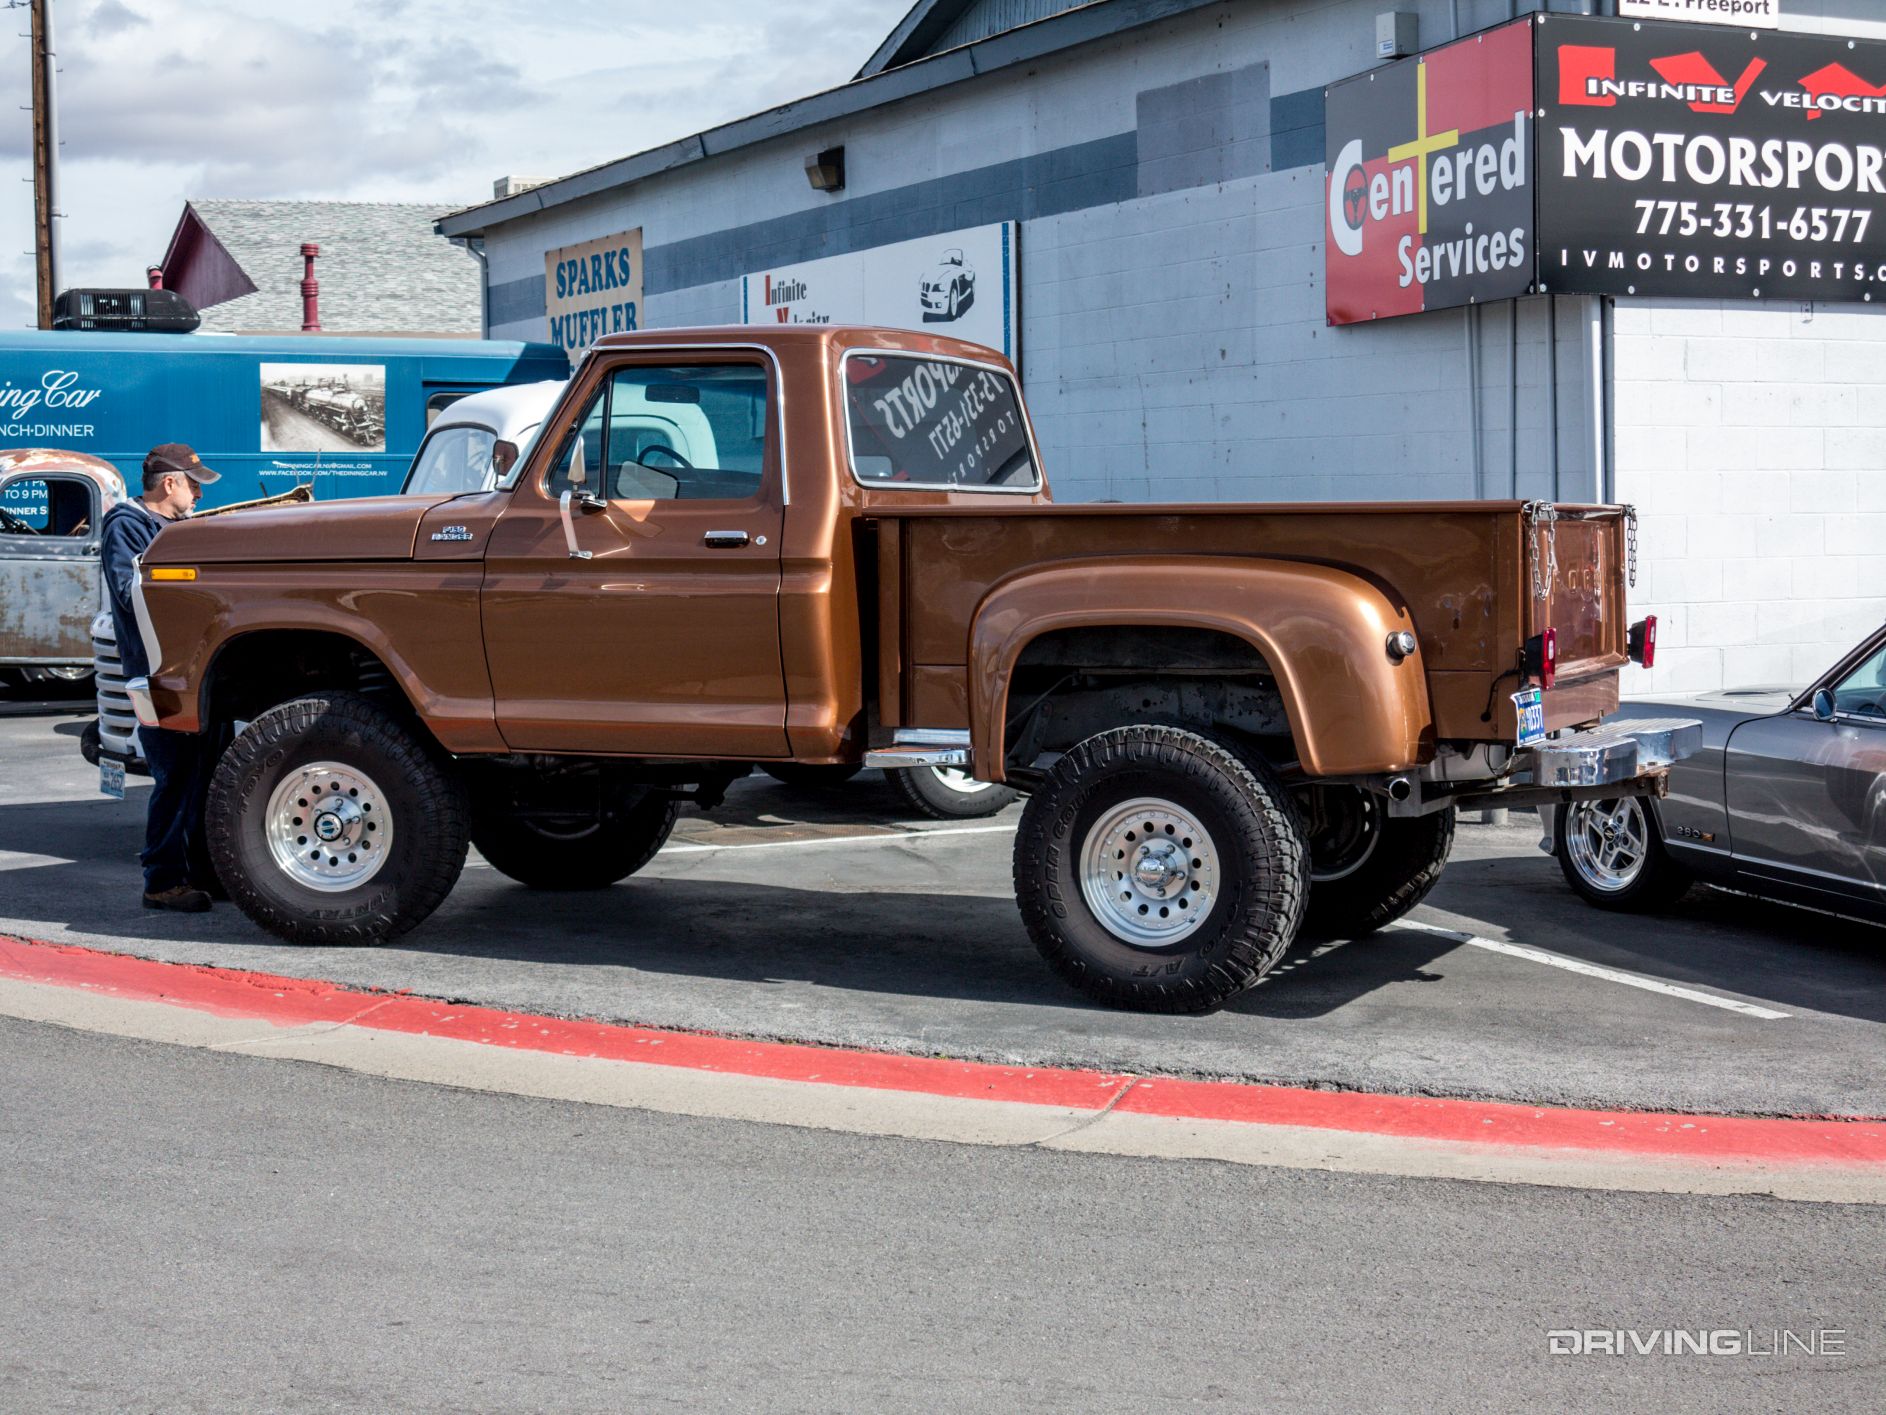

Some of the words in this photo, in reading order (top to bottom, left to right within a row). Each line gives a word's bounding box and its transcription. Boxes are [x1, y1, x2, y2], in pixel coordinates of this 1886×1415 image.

[1587, 78, 1736, 105] INFINITE
[1559, 127, 1886, 194] MOTORSPOR
[1634, 199, 1872, 243] 775-331-6577
[556, 247, 630, 299] SPARKS
[1398, 222, 1525, 288] Services
[765, 274, 807, 306] Infinite
[550, 301, 637, 350] MUFFLER
[42, 369, 102, 408] Car
[22, 490, 29, 499] 9
